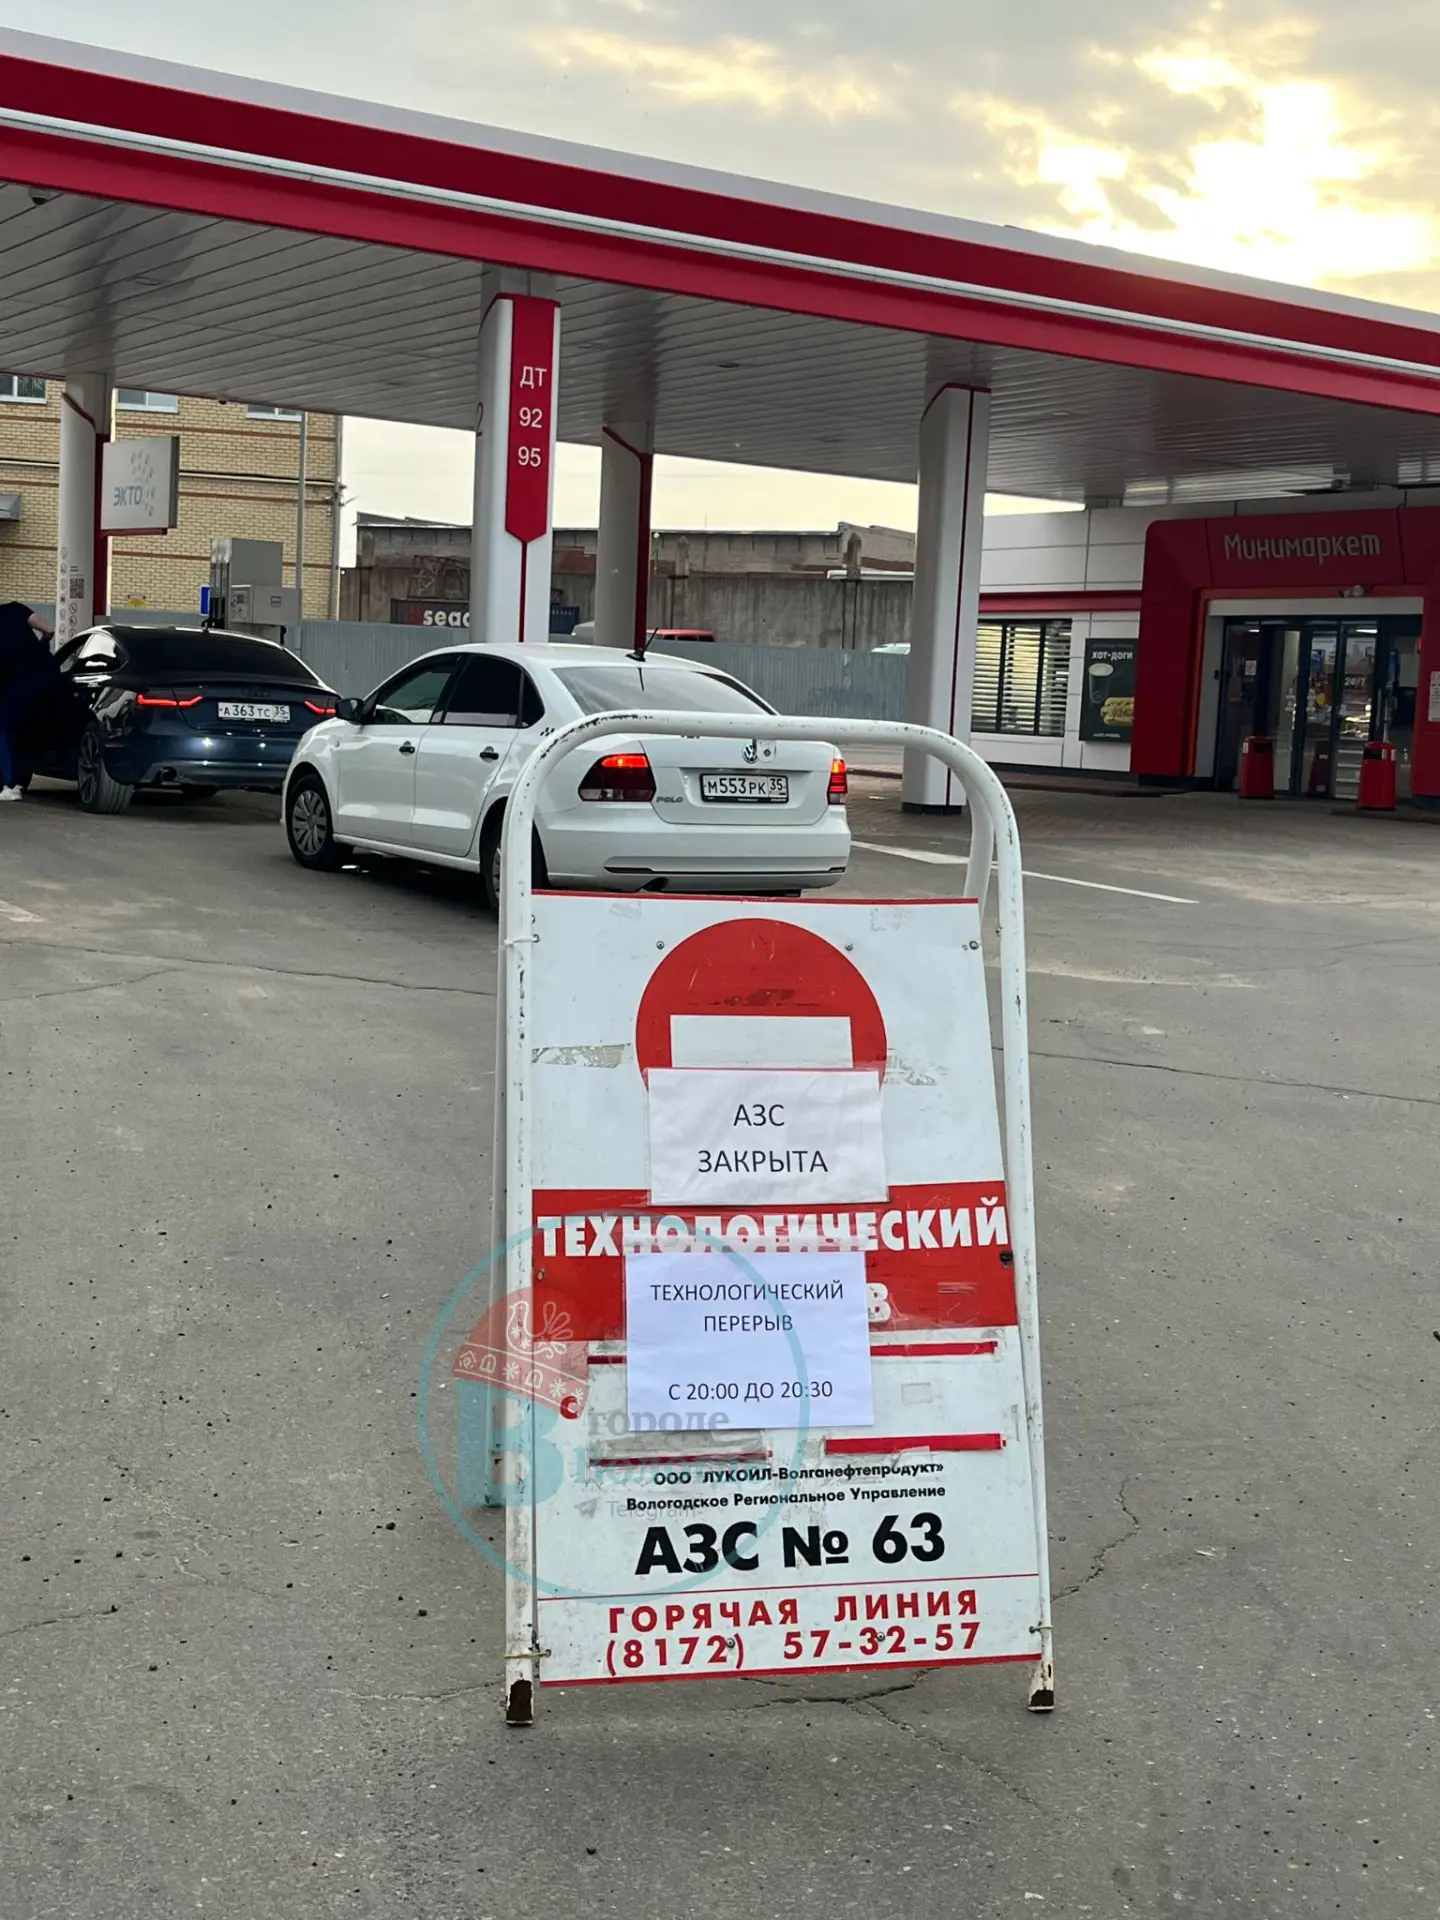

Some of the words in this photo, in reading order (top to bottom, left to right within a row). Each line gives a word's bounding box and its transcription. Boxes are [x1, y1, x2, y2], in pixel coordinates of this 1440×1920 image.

[520, 366, 547, 389] ДТ
[519, 407, 542, 428] 92
[518, 446, 541, 467] 95
[113, 486, 142, 506] ЭКТО
[1224, 533, 1380, 566] Минимаркет
[656, 795, 684, 804] POLO
[733, 1103, 785, 1127] АЗС
[698, 1150, 828, 1173] ЗАКРЫТА
[537, 1196, 1009, 1257] ТЕХНОЛОГИЧЕСКИЙ
[650, 1279, 843, 1301] ТЕХНОЛОГИЧЕСКИЙ
[704, 1314, 793, 1332] ПЕРЕРЫВ
[668, 1383, 681, 1400] С
[686, 1382, 739, 1400] 20:00
[744, 1382, 774, 1403] ДО
[780, 1380, 833, 1398] 20:30
[654, 1471, 691, 1485] ООО
[626, 1495, 729, 1511] Вологодское
[733, 1491, 845, 1507] Региональное
[850, 1486, 946, 1502] Управление
[634, 1521, 760, 1575] АЗС
[781, 1525, 849, 1568] №
[872, 1512, 945, 1564] 63
[609, 1598, 798, 1633] ГОРЯЧАЯ
[834, 1589, 977, 1622] ЛИНИЯ
[606, 1632, 744, 1677] (8172)
[783, 1621, 981, 1660] 57-32-57
